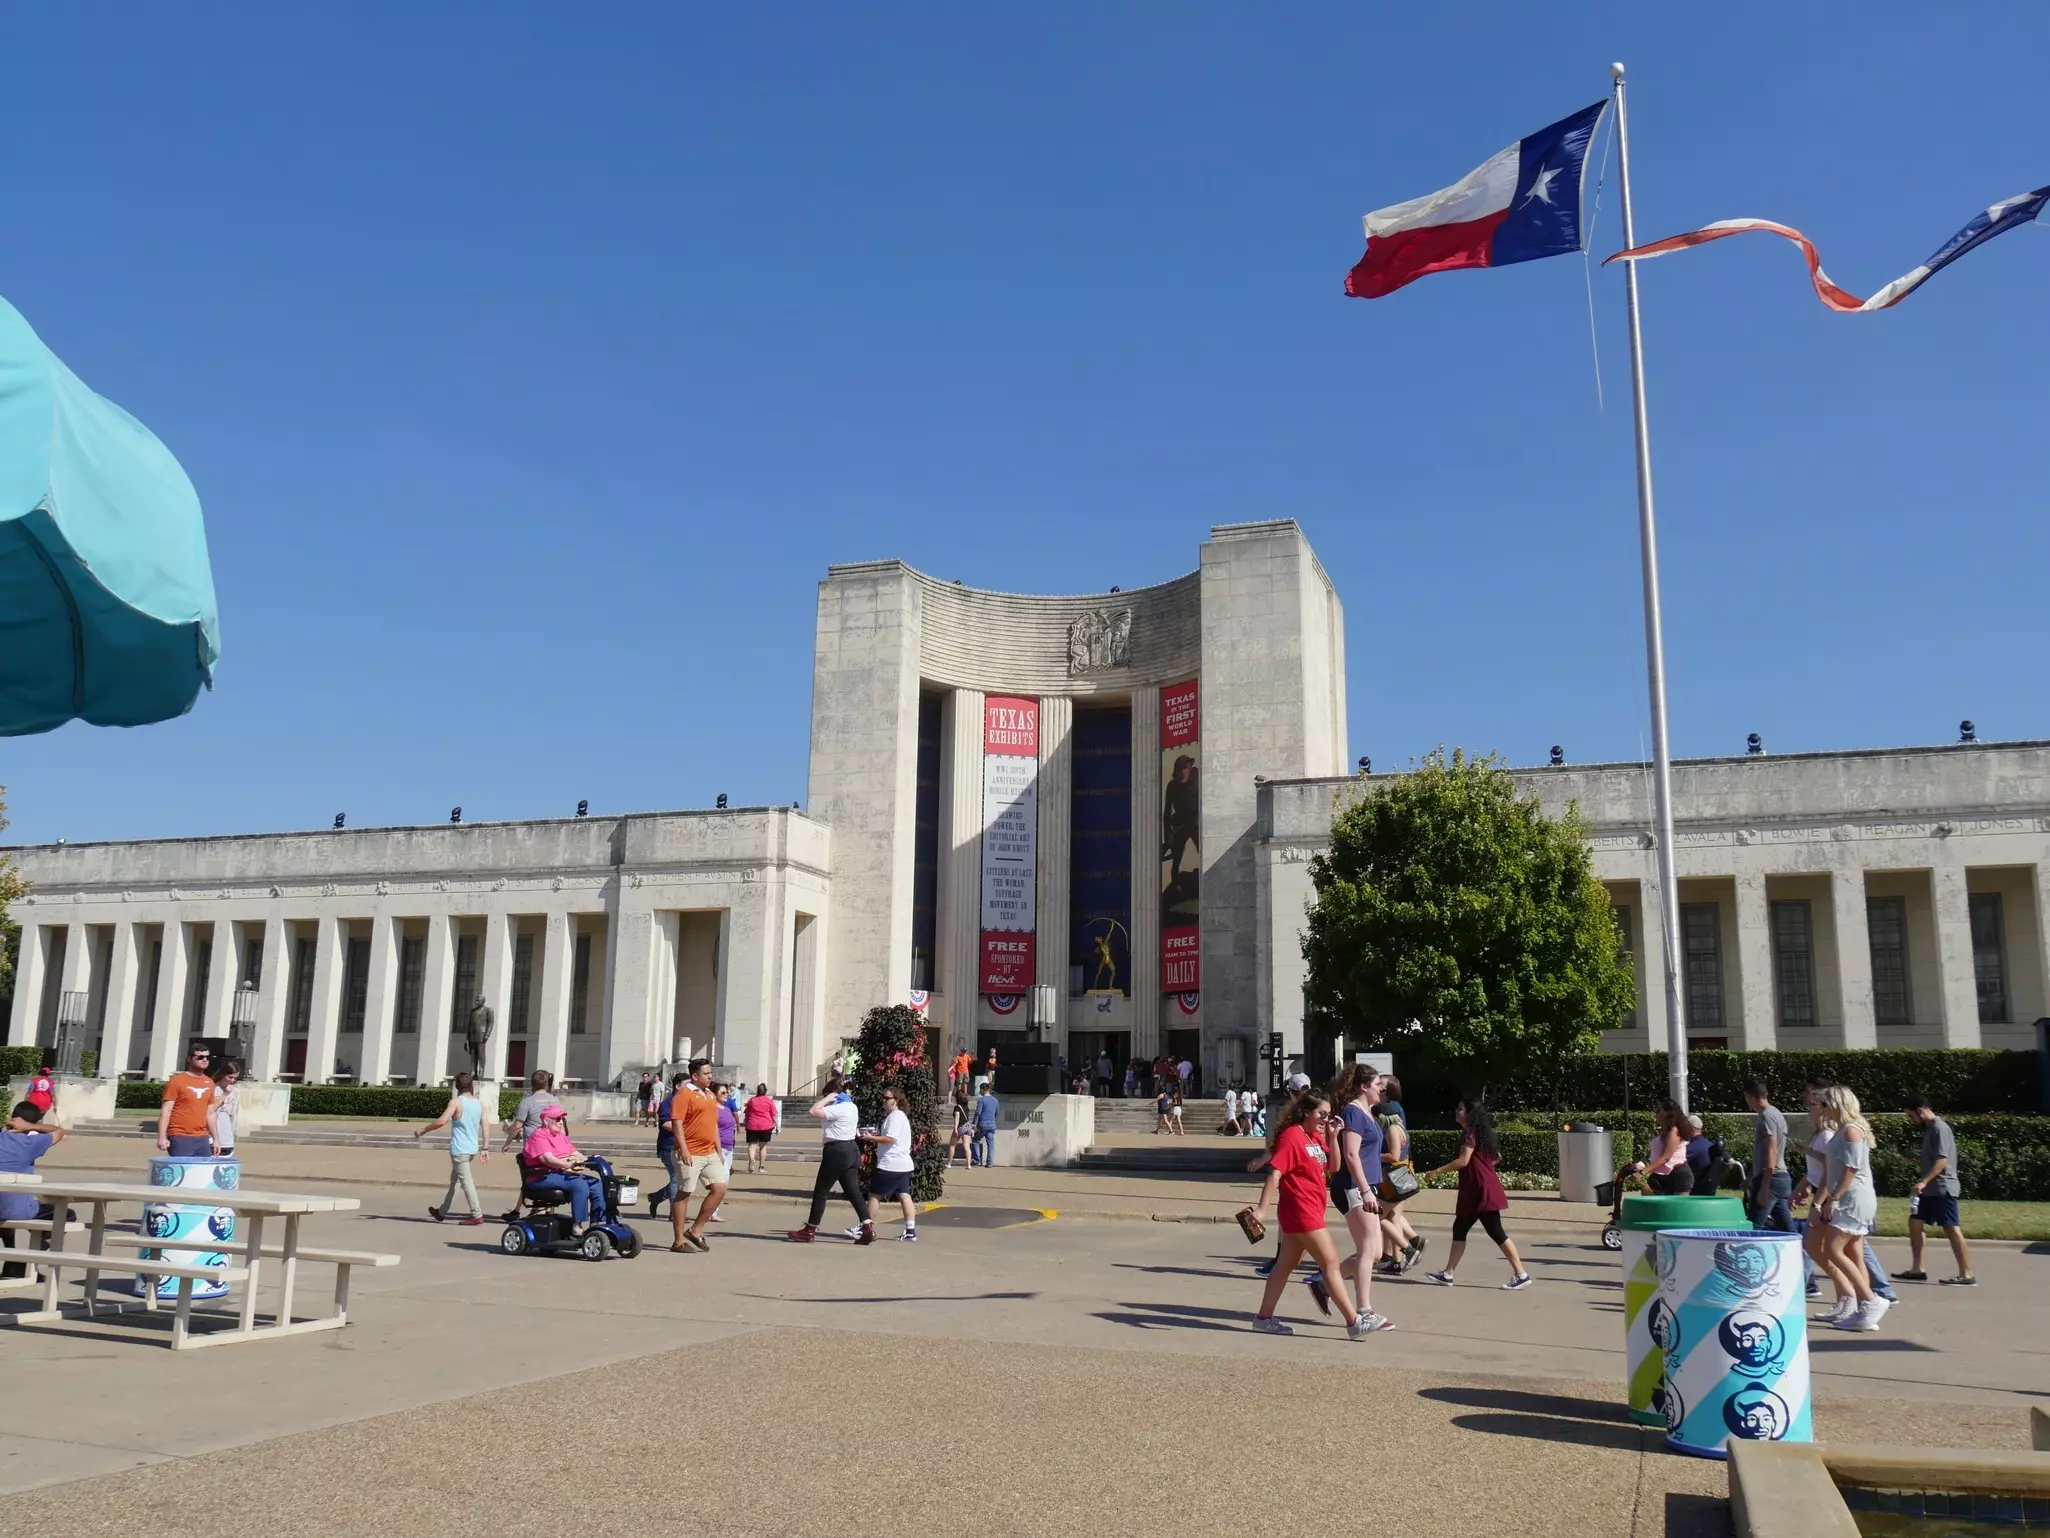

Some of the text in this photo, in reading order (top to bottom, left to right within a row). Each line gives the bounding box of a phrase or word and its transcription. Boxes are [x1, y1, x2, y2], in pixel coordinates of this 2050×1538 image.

[1165, 692, 1195, 706] TEXAS
[1178, 703, 1190, 711] THE
[990, 708, 1034, 730] TEXAS
[1166, 709, 1196, 724] FIRST
[1168, 720, 1192, 730] WORLD
[989, 730, 1034, 745] EXHIBITS
[1172, 728, 1188, 737] WAR
[997, 811, 1023, 820] DRAWING
[1015, 822, 1026, 831] THE
[1865, 823, 1926, 836] REAGAN
[1970, 819, 2024, 831] JONES
[989, 832, 1031, 842] EDITORIAL ART
[1673, 831, 1727, 844] ZAVALA
[1772, 828, 1821, 839] BOWIE
[992, 878, 1003, 887] THE
[995, 889, 1023, 898] SUFFRAGE
[989, 900, 1019, 909] MOVEMENT
[1000, 911, 1017, 921] TEXAS
[988, 941, 1028, 951] FREE
[1167, 936, 1195, 948] FREE
[991, 954, 1024, 964] SPONSORED
[1003, 964, 1012, 974] BY
[1167, 961, 1196, 983] DAILY
[1005, 1110, 1044, 1123] HALL OF STATE
